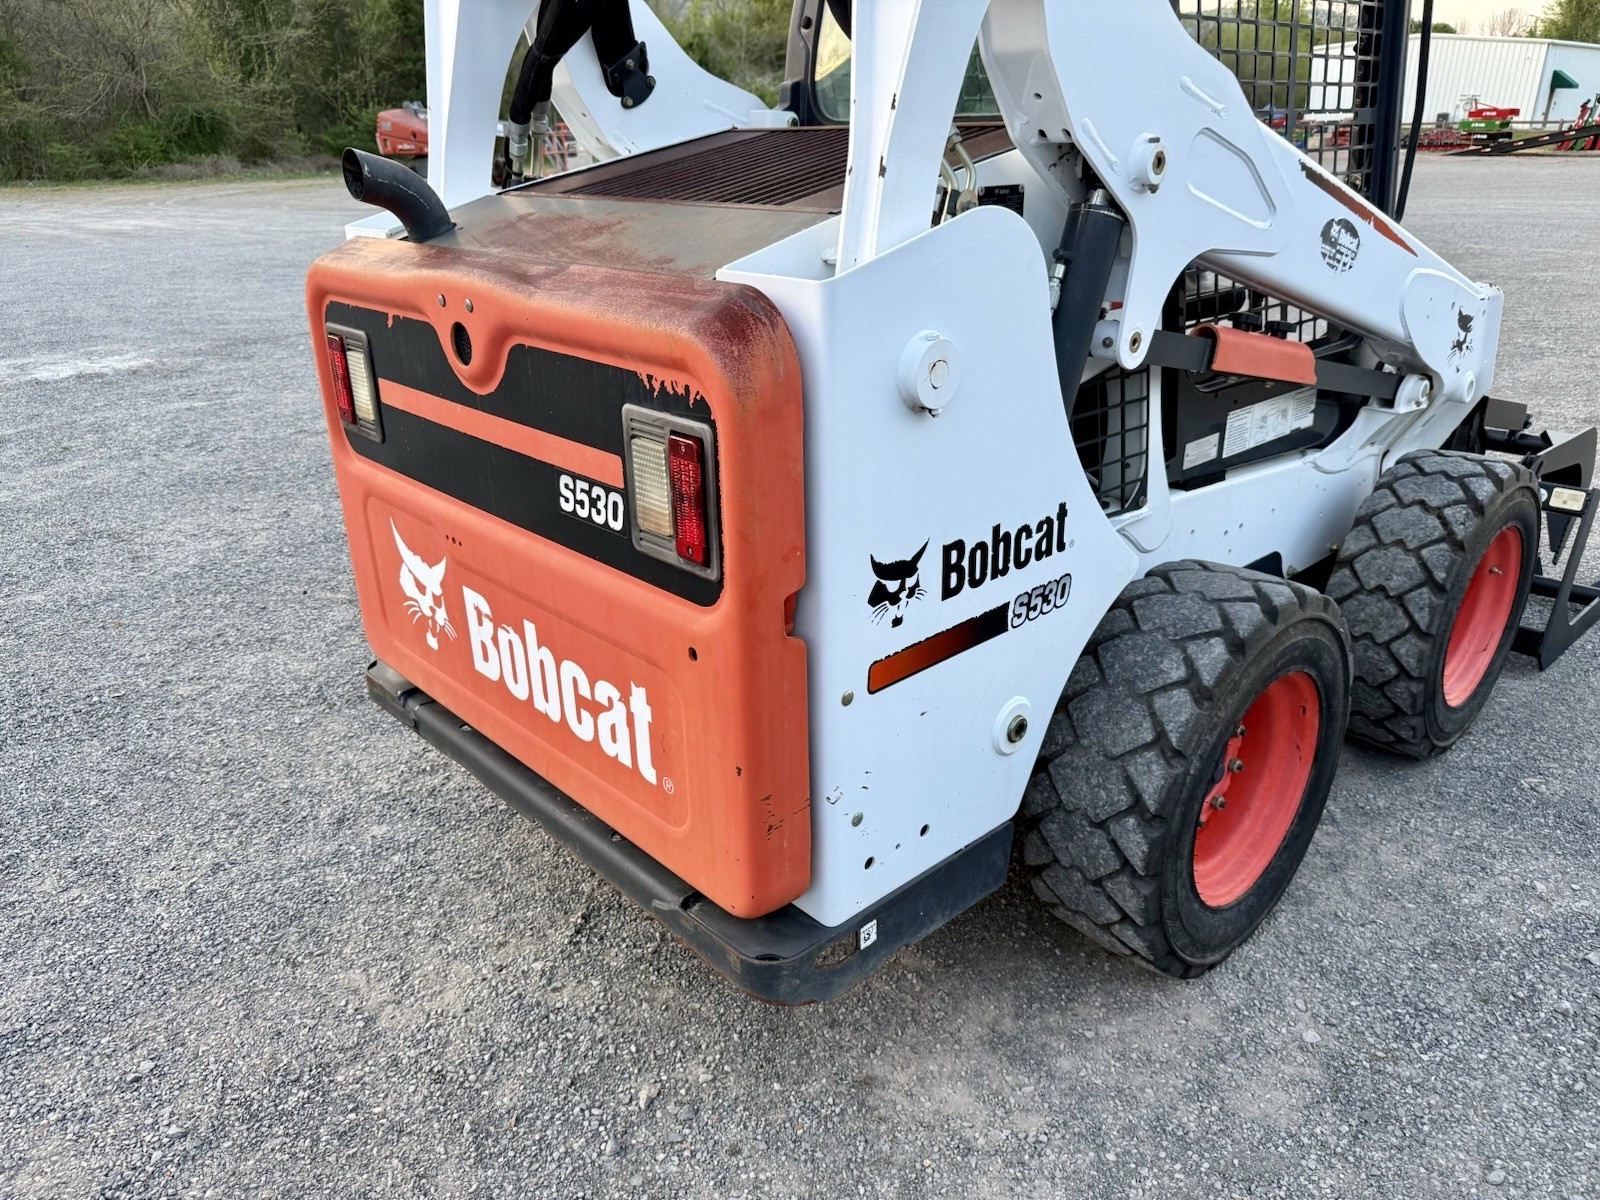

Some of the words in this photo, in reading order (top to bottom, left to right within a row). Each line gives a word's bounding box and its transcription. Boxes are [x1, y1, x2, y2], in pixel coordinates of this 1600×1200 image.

[559, 474, 625, 532] S530
[941, 502, 1068, 601] Bobcat
[1011, 572, 1072, 629] S530
[462, 585, 657, 785] Bobcat
